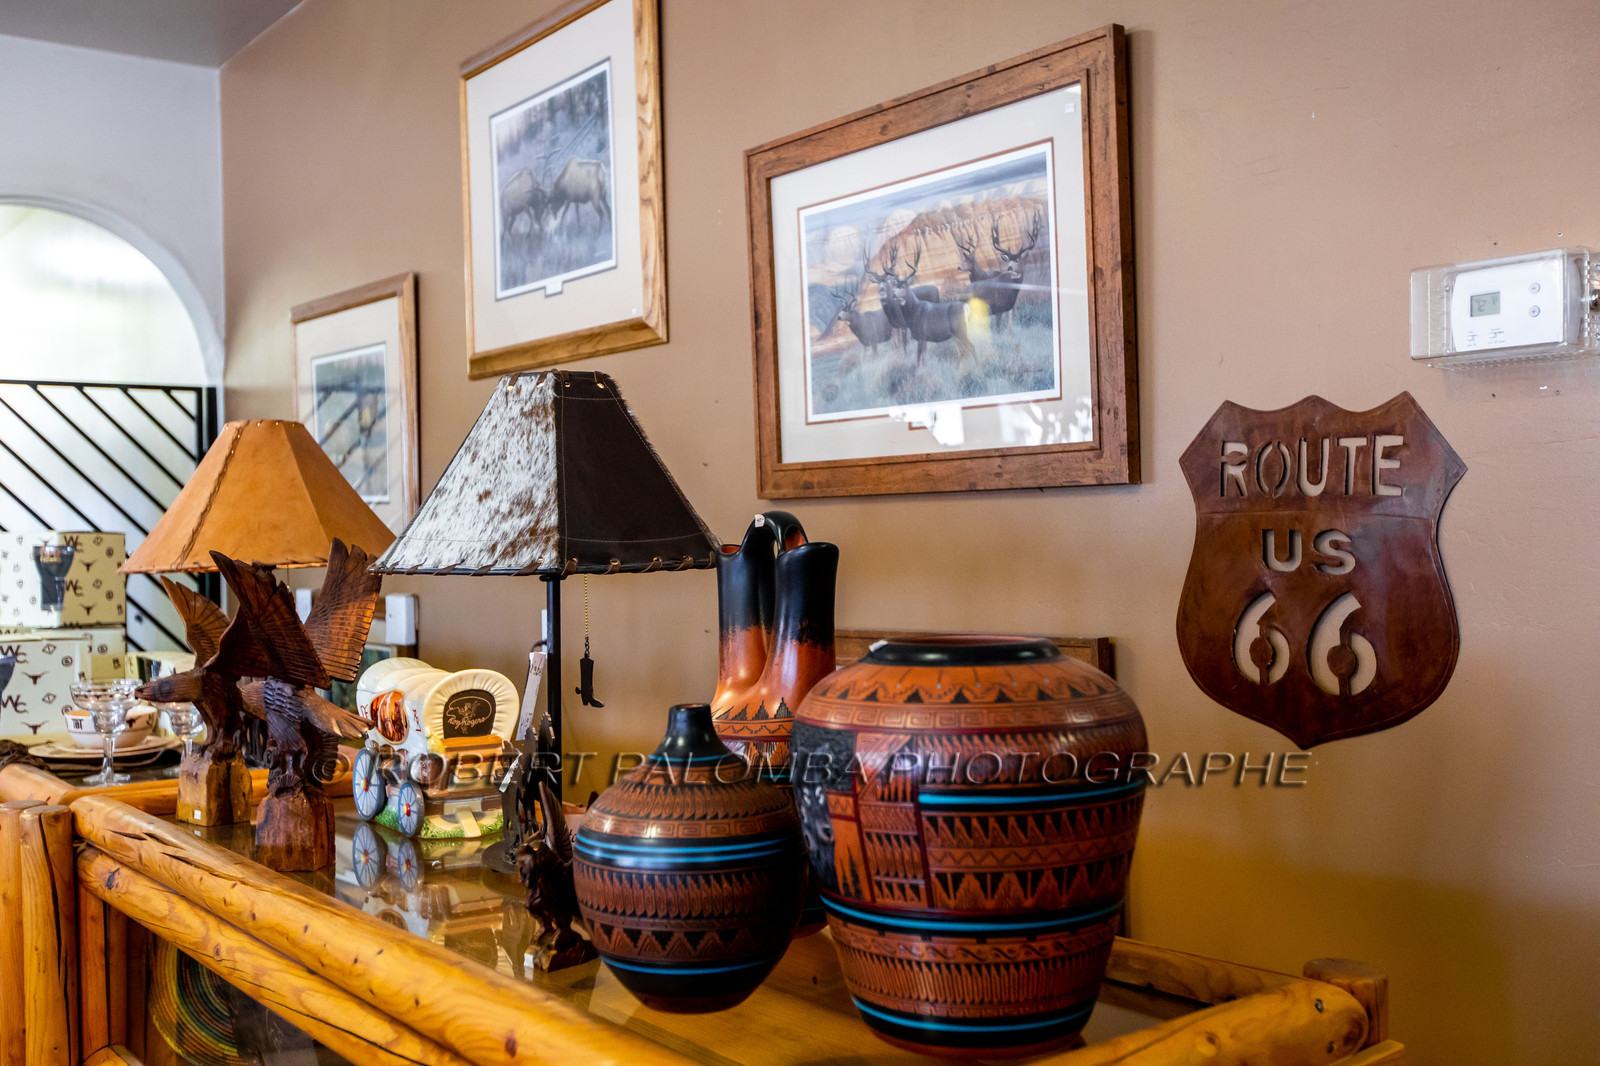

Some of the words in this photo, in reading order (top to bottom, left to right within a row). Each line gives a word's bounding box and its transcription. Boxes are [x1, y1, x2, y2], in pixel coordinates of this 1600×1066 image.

[1220, 434, 1404, 498] ROUTE
[1262, 529, 1357, 576] US
[1232, 590, 1378, 696] 66
